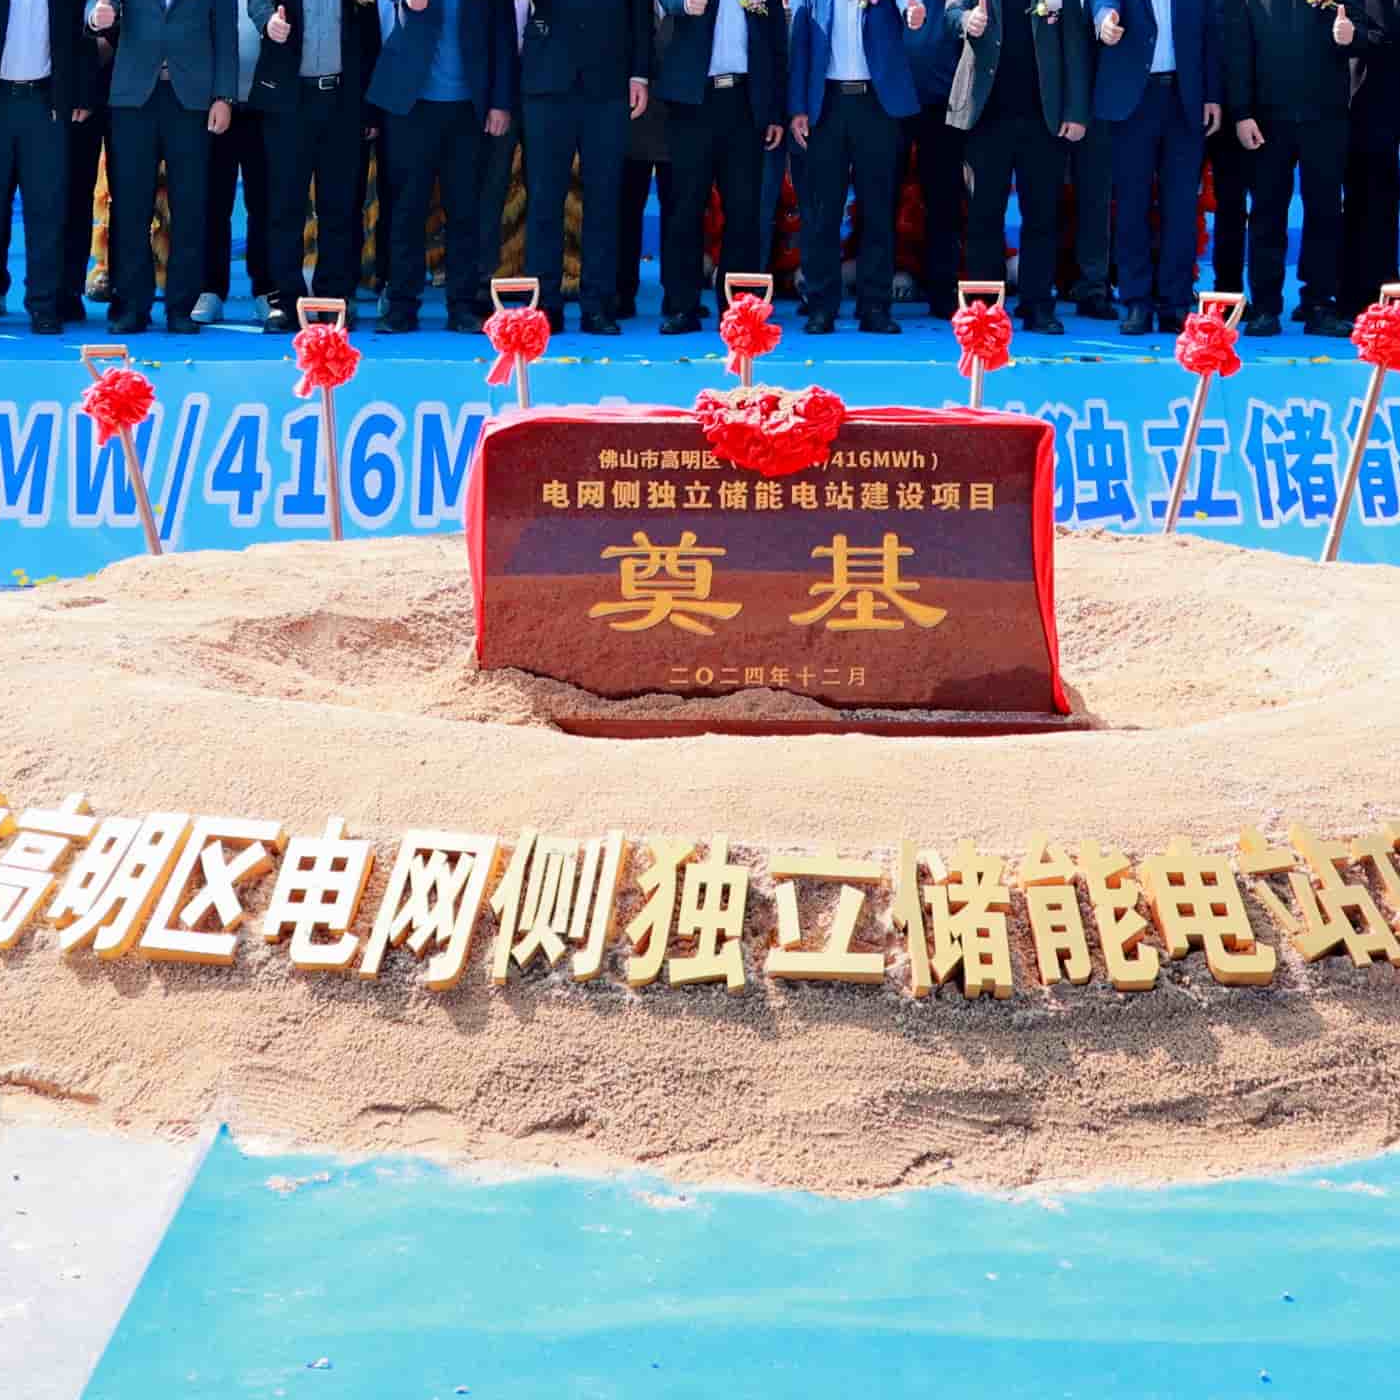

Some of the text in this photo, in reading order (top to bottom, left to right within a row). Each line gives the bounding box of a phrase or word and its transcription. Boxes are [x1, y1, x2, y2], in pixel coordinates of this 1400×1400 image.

[541, 479, 997, 511] 电网侧独立储能电站建设项目
[588, 530, 949, 636] 奠基
